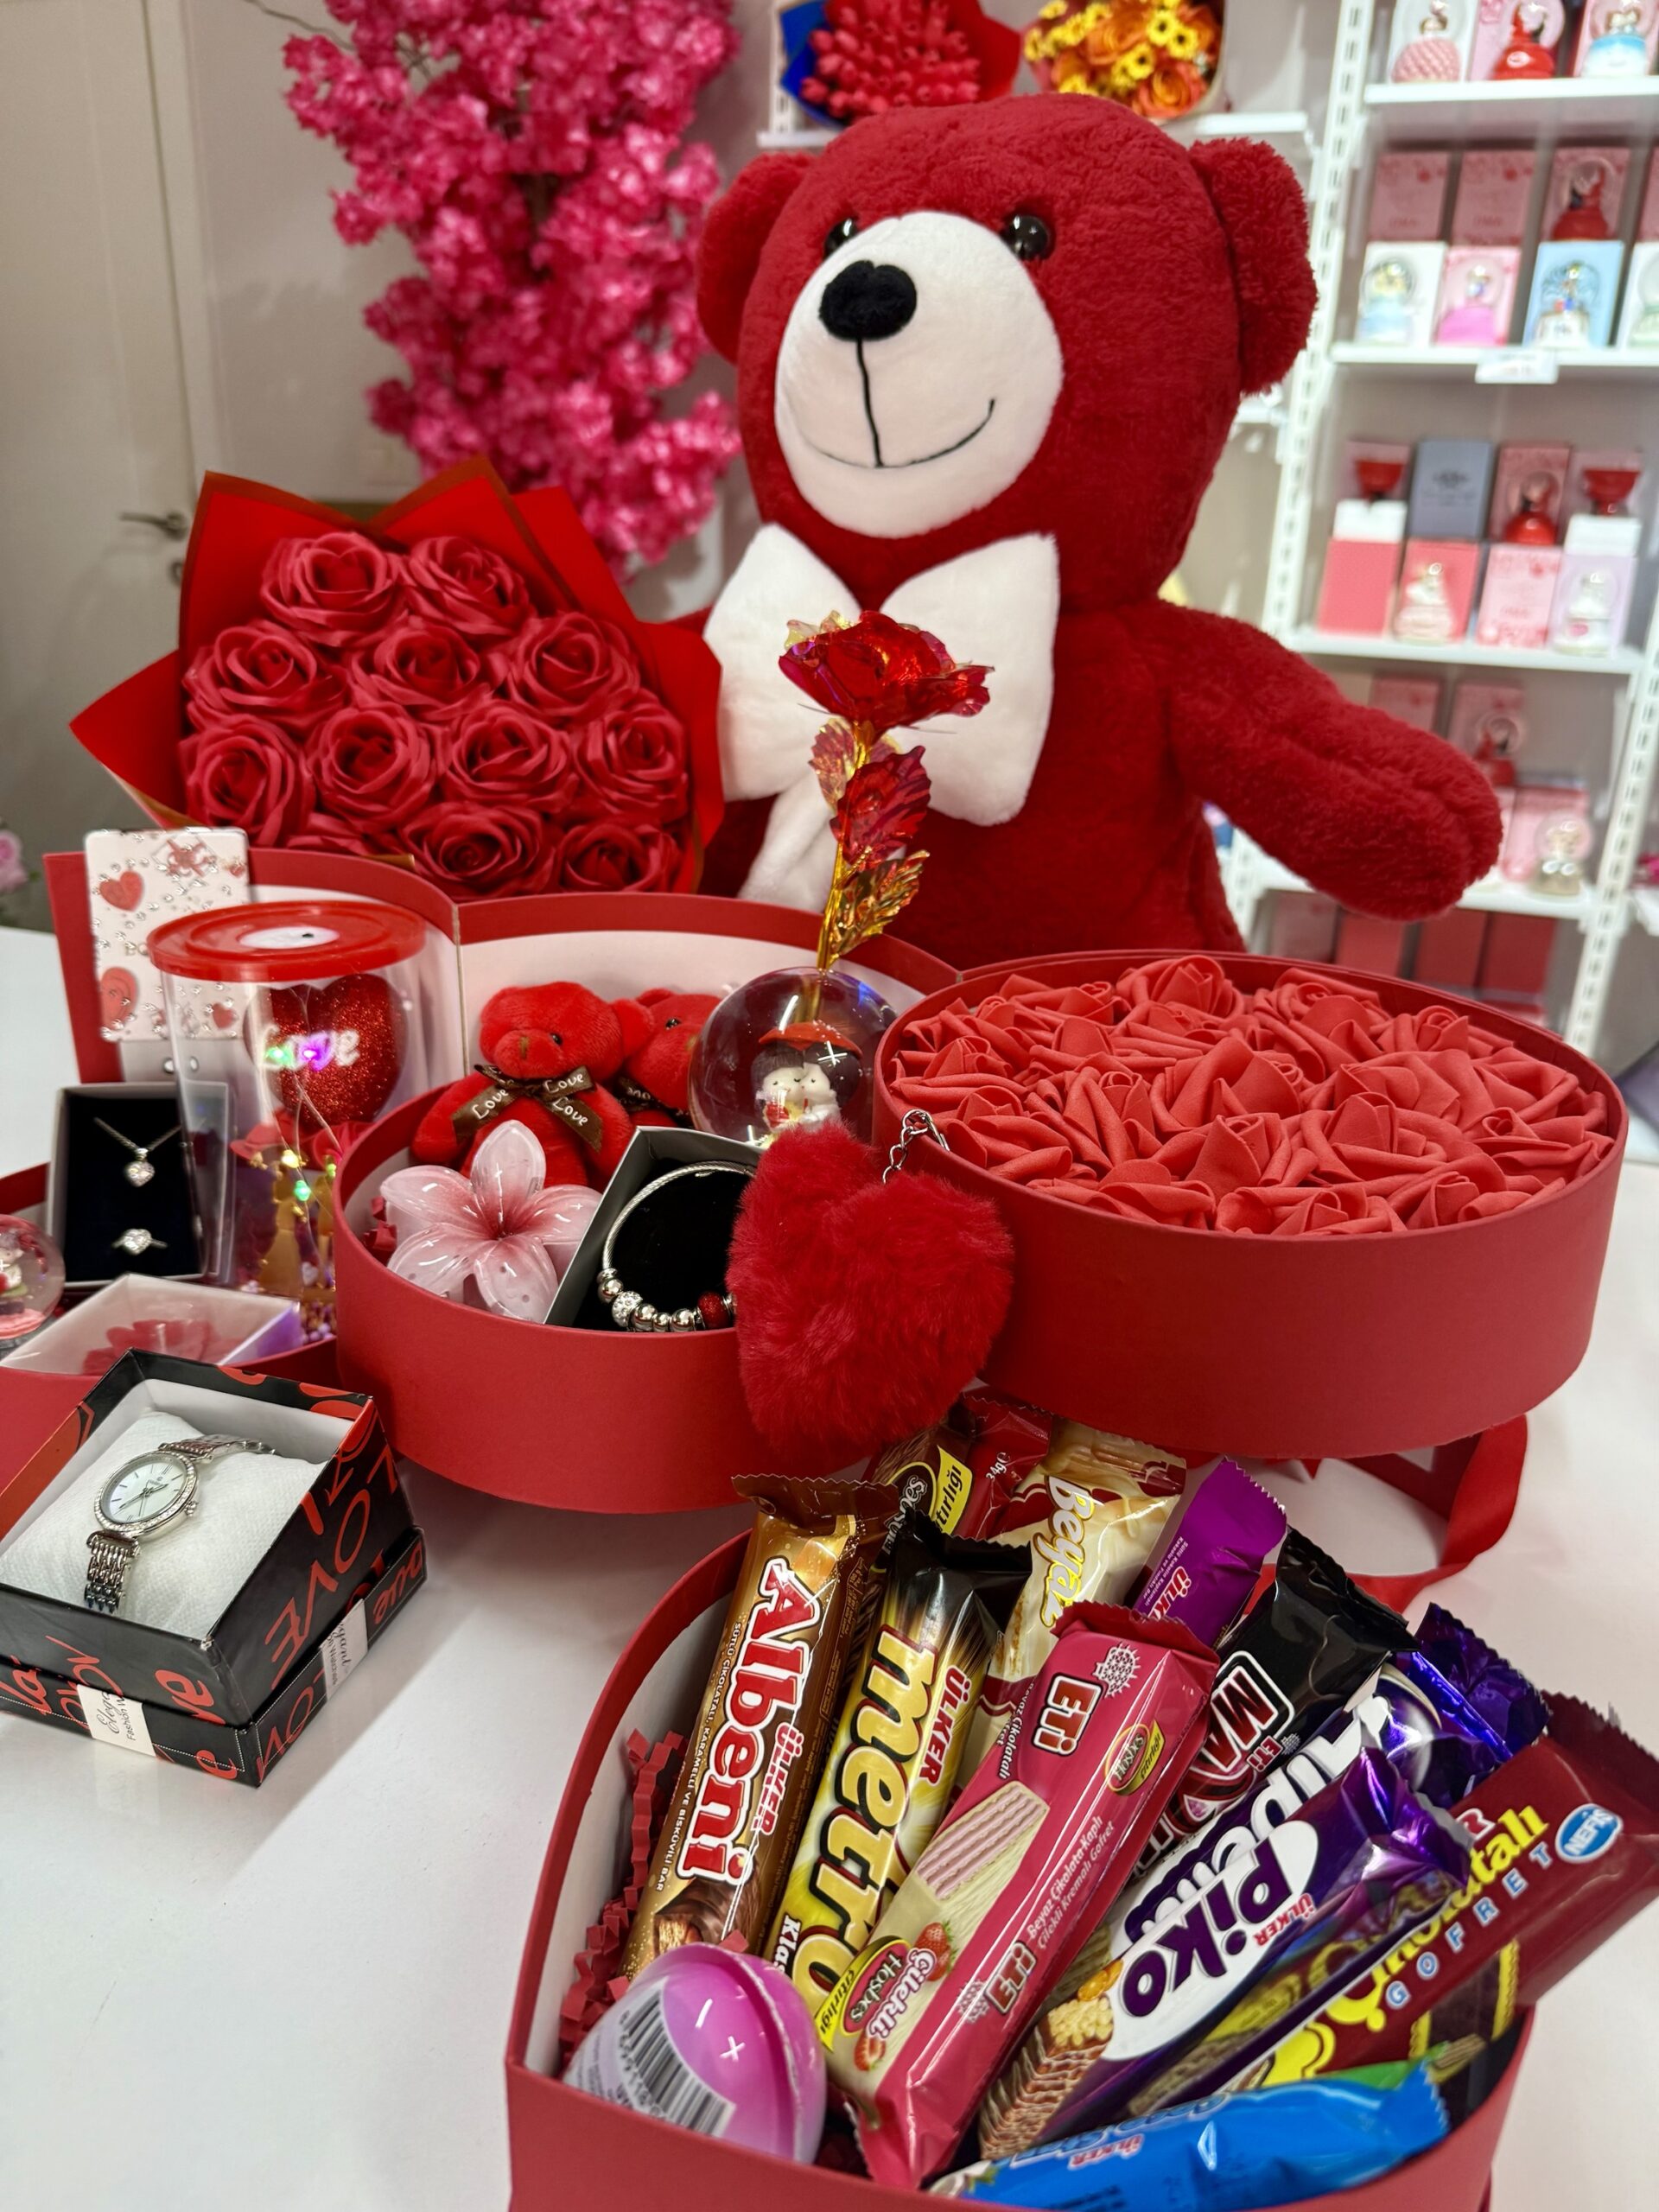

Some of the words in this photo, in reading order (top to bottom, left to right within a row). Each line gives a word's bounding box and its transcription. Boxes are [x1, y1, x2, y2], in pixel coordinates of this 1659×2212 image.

[472, 1090, 509, 1120] Love
[543, 1073, 584, 1093] Love
[553, 1096, 588, 1126] Love
[264, 1445, 397, 1690] LOVE
[1033, 1475, 1096, 1627] Beyaz
[1147, 1566, 1192, 1620] ÜLK
[728, 1622, 741, 1656] SÜTLÜ
[119, 1706, 136, 1741] Fashion
[677, 1558, 821, 1885] Albeni
[919, 1662, 971, 1786] ÜLKER
[998, 1715, 1023, 1780] Çikolatalı
[681, 1792, 690, 1807] VE
[750, 1721, 804, 1835] ÜLKER
[790, 1624, 940, 1998] metro
[1135, 1692, 1393, 1932] Alpe
[655, 1871, 670, 1892] BAR
[1037, 1908, 1063, 1949] Çilekli
[1061, 1860, 1091, 1910] Kremalı
[1090, 1821, 1115, 1861] Gofret
[1027, 1898, 1055, 1939] Beyaz
[1253, 1891, 1316, 1948] ÜLKER
[867, 1948, 938, 2040] Çilekli
